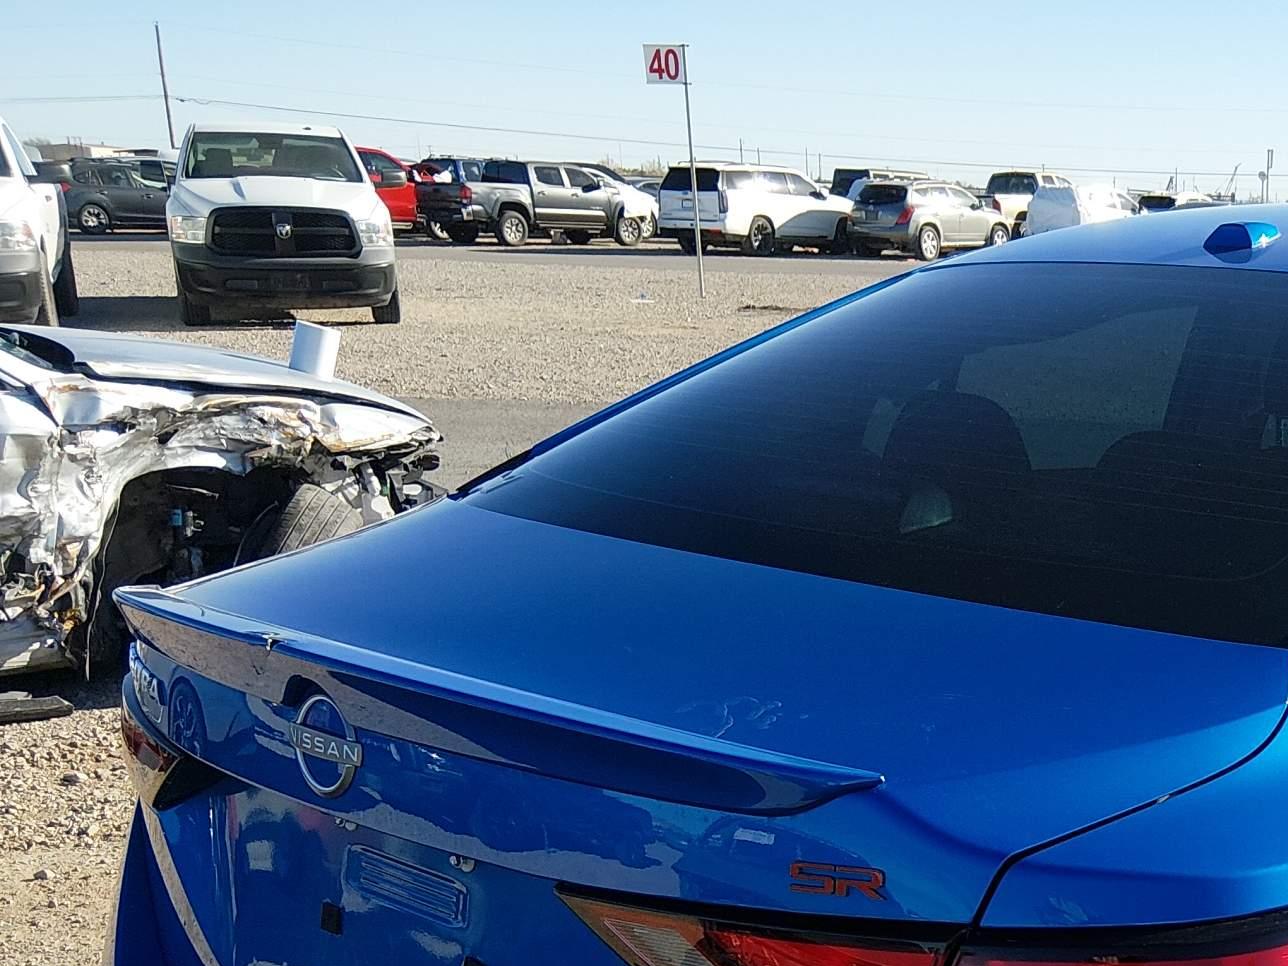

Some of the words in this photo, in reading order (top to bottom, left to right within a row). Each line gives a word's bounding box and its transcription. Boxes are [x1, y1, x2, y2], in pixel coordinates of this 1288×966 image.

[649, 48, 680, 81] 40
[290, 726, 359, 763] NISSAN
[789, 860, 887, 901] SR
